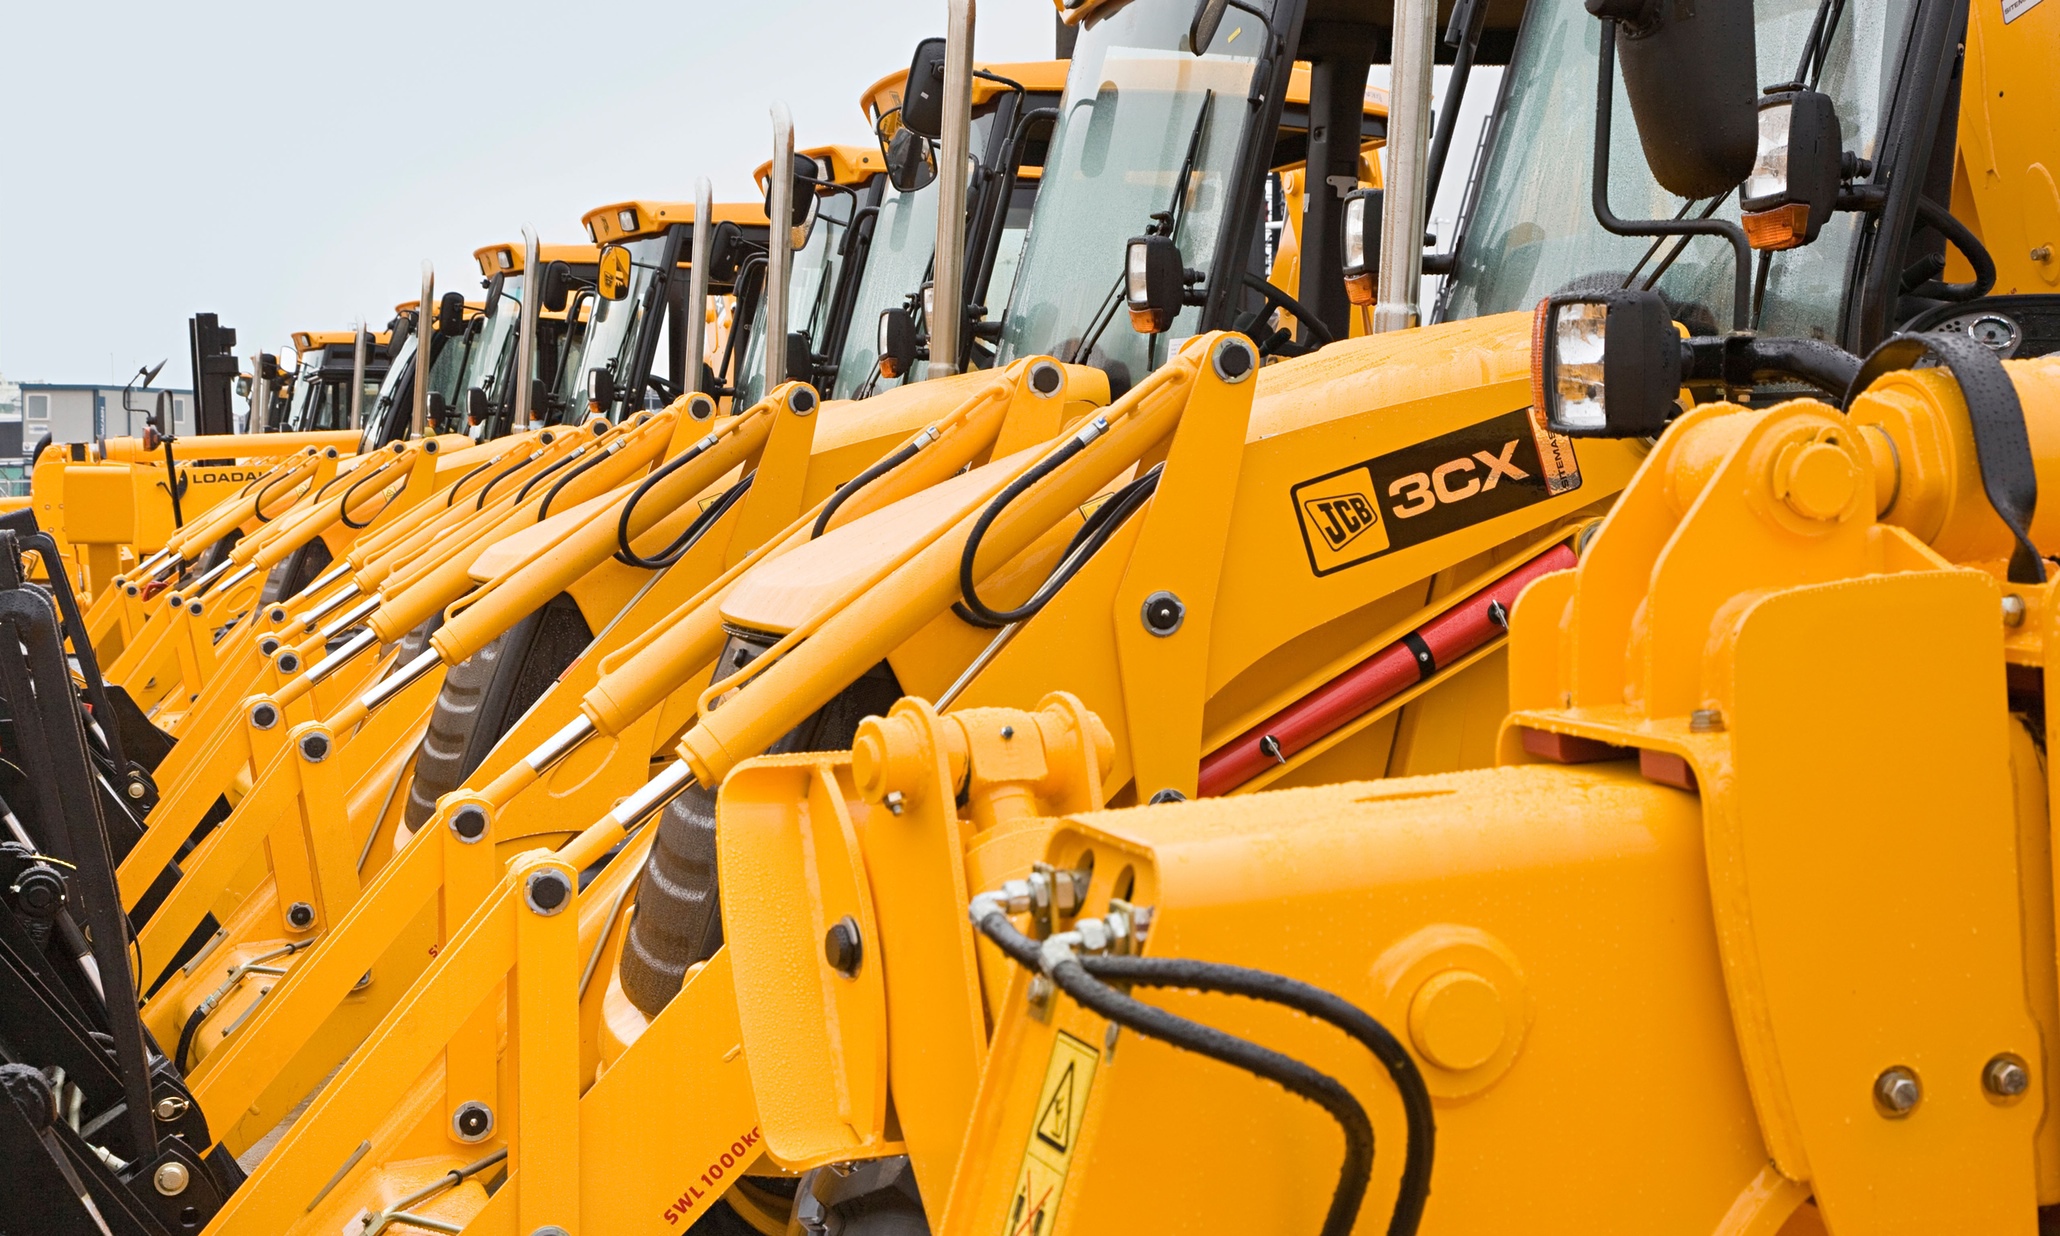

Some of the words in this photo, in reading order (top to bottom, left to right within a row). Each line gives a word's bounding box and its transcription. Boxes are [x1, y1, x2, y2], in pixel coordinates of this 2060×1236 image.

[1388, 439, 1531, 520] 3CX
[1316, 498, 1373, 545] JCB
[664, 1186, 705, 1226] SWL
